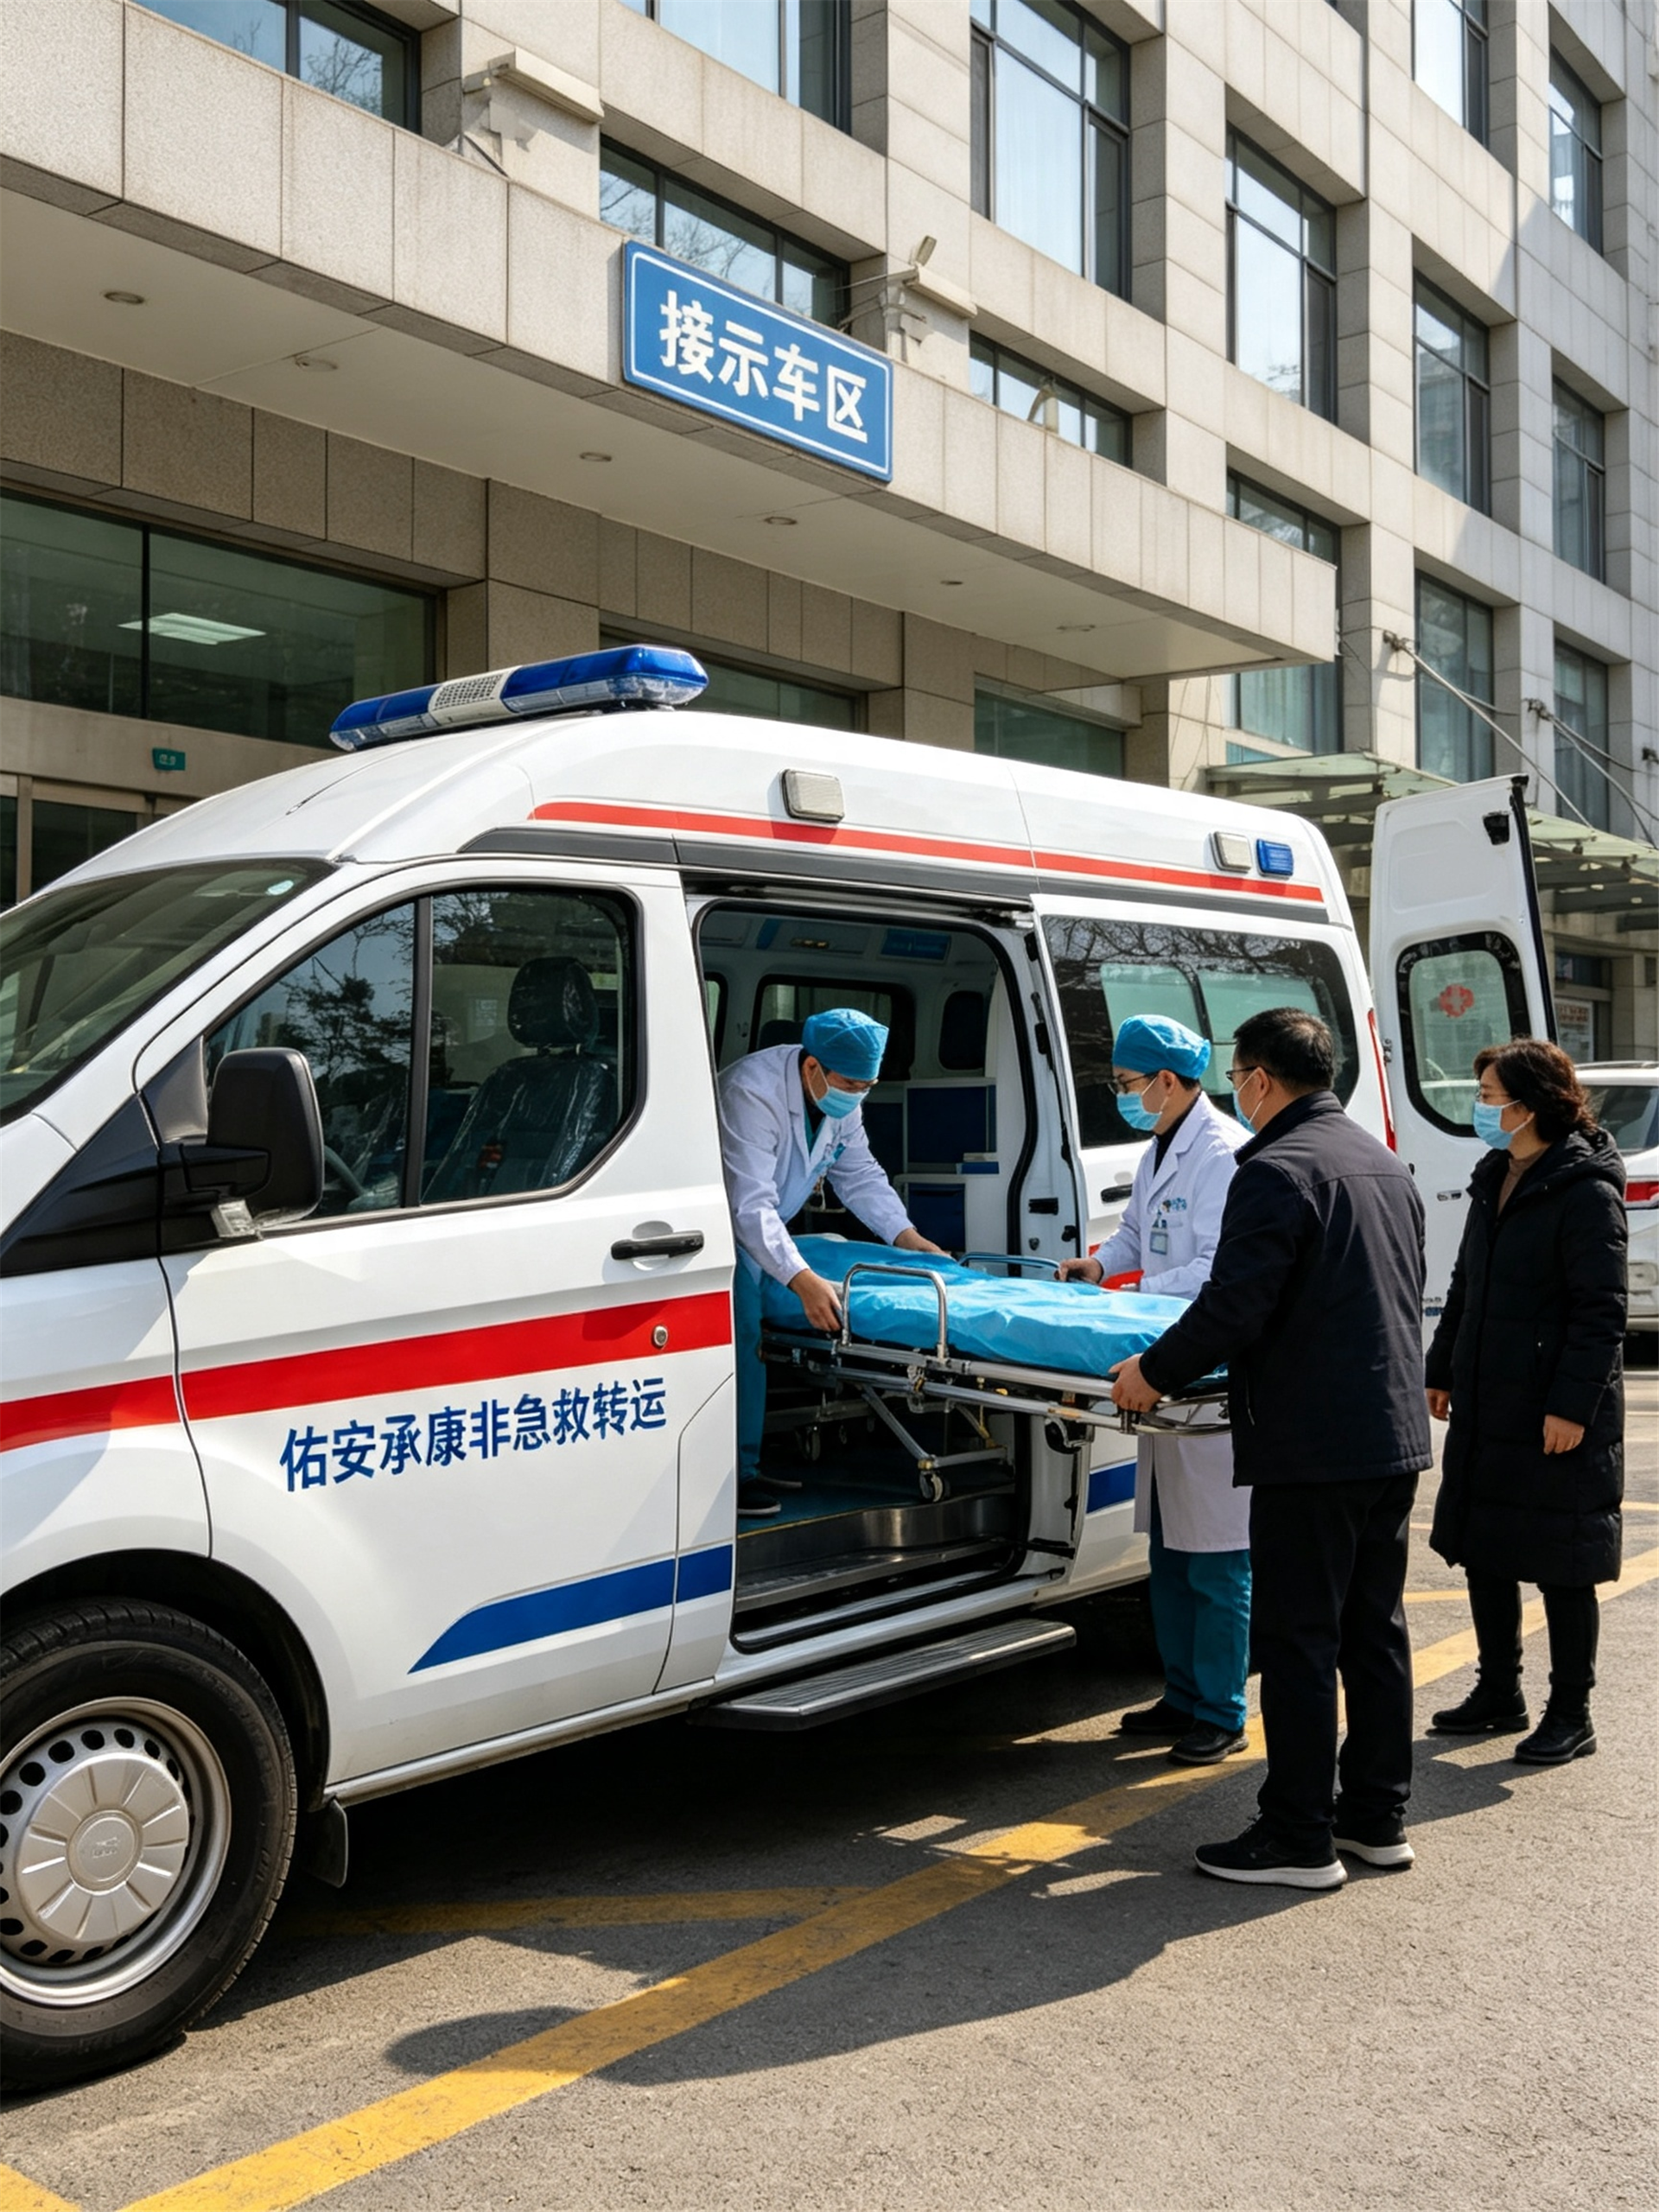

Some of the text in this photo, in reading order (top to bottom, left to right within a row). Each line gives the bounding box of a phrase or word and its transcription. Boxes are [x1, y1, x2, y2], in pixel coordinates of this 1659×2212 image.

[659, 290, 868, 443] 接示车区
[280, 1377, 667, 1491] 佑安承康非急救转运
